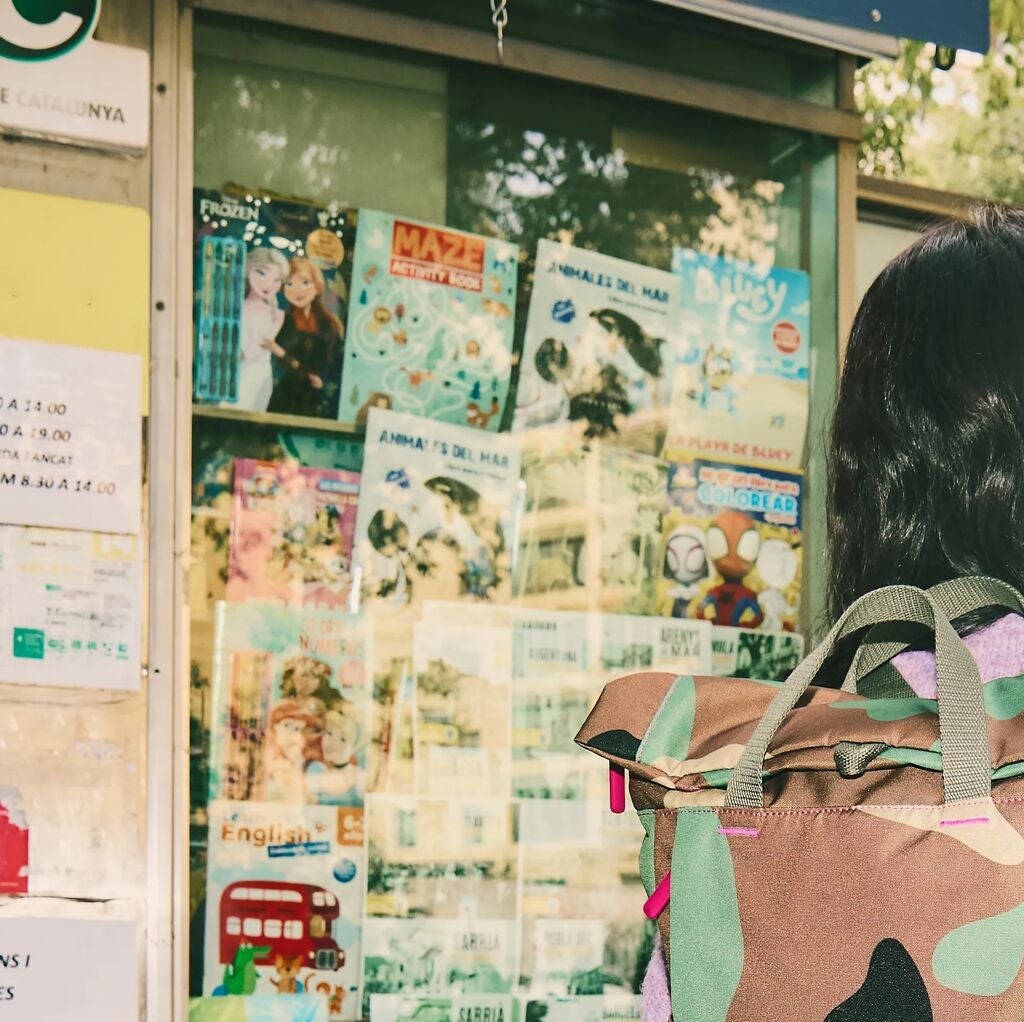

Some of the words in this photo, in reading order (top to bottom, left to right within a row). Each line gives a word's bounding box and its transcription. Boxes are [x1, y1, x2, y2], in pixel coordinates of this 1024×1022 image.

[16, 90, 126, 124] CATALUNYA
[200, 198, 259, 221] FROZEN
[393, 225, 486, 272] MAZE
[391, 260, 448, 284] ACTIVITY
[449, 271, 482, 292] BOOK
[547, 262, 612, 288] ANIMALES
[642, 286, 669, 303] MAR
[700, 486, 796, 512] COLOREAR
[221, 823, 311, 847] English
